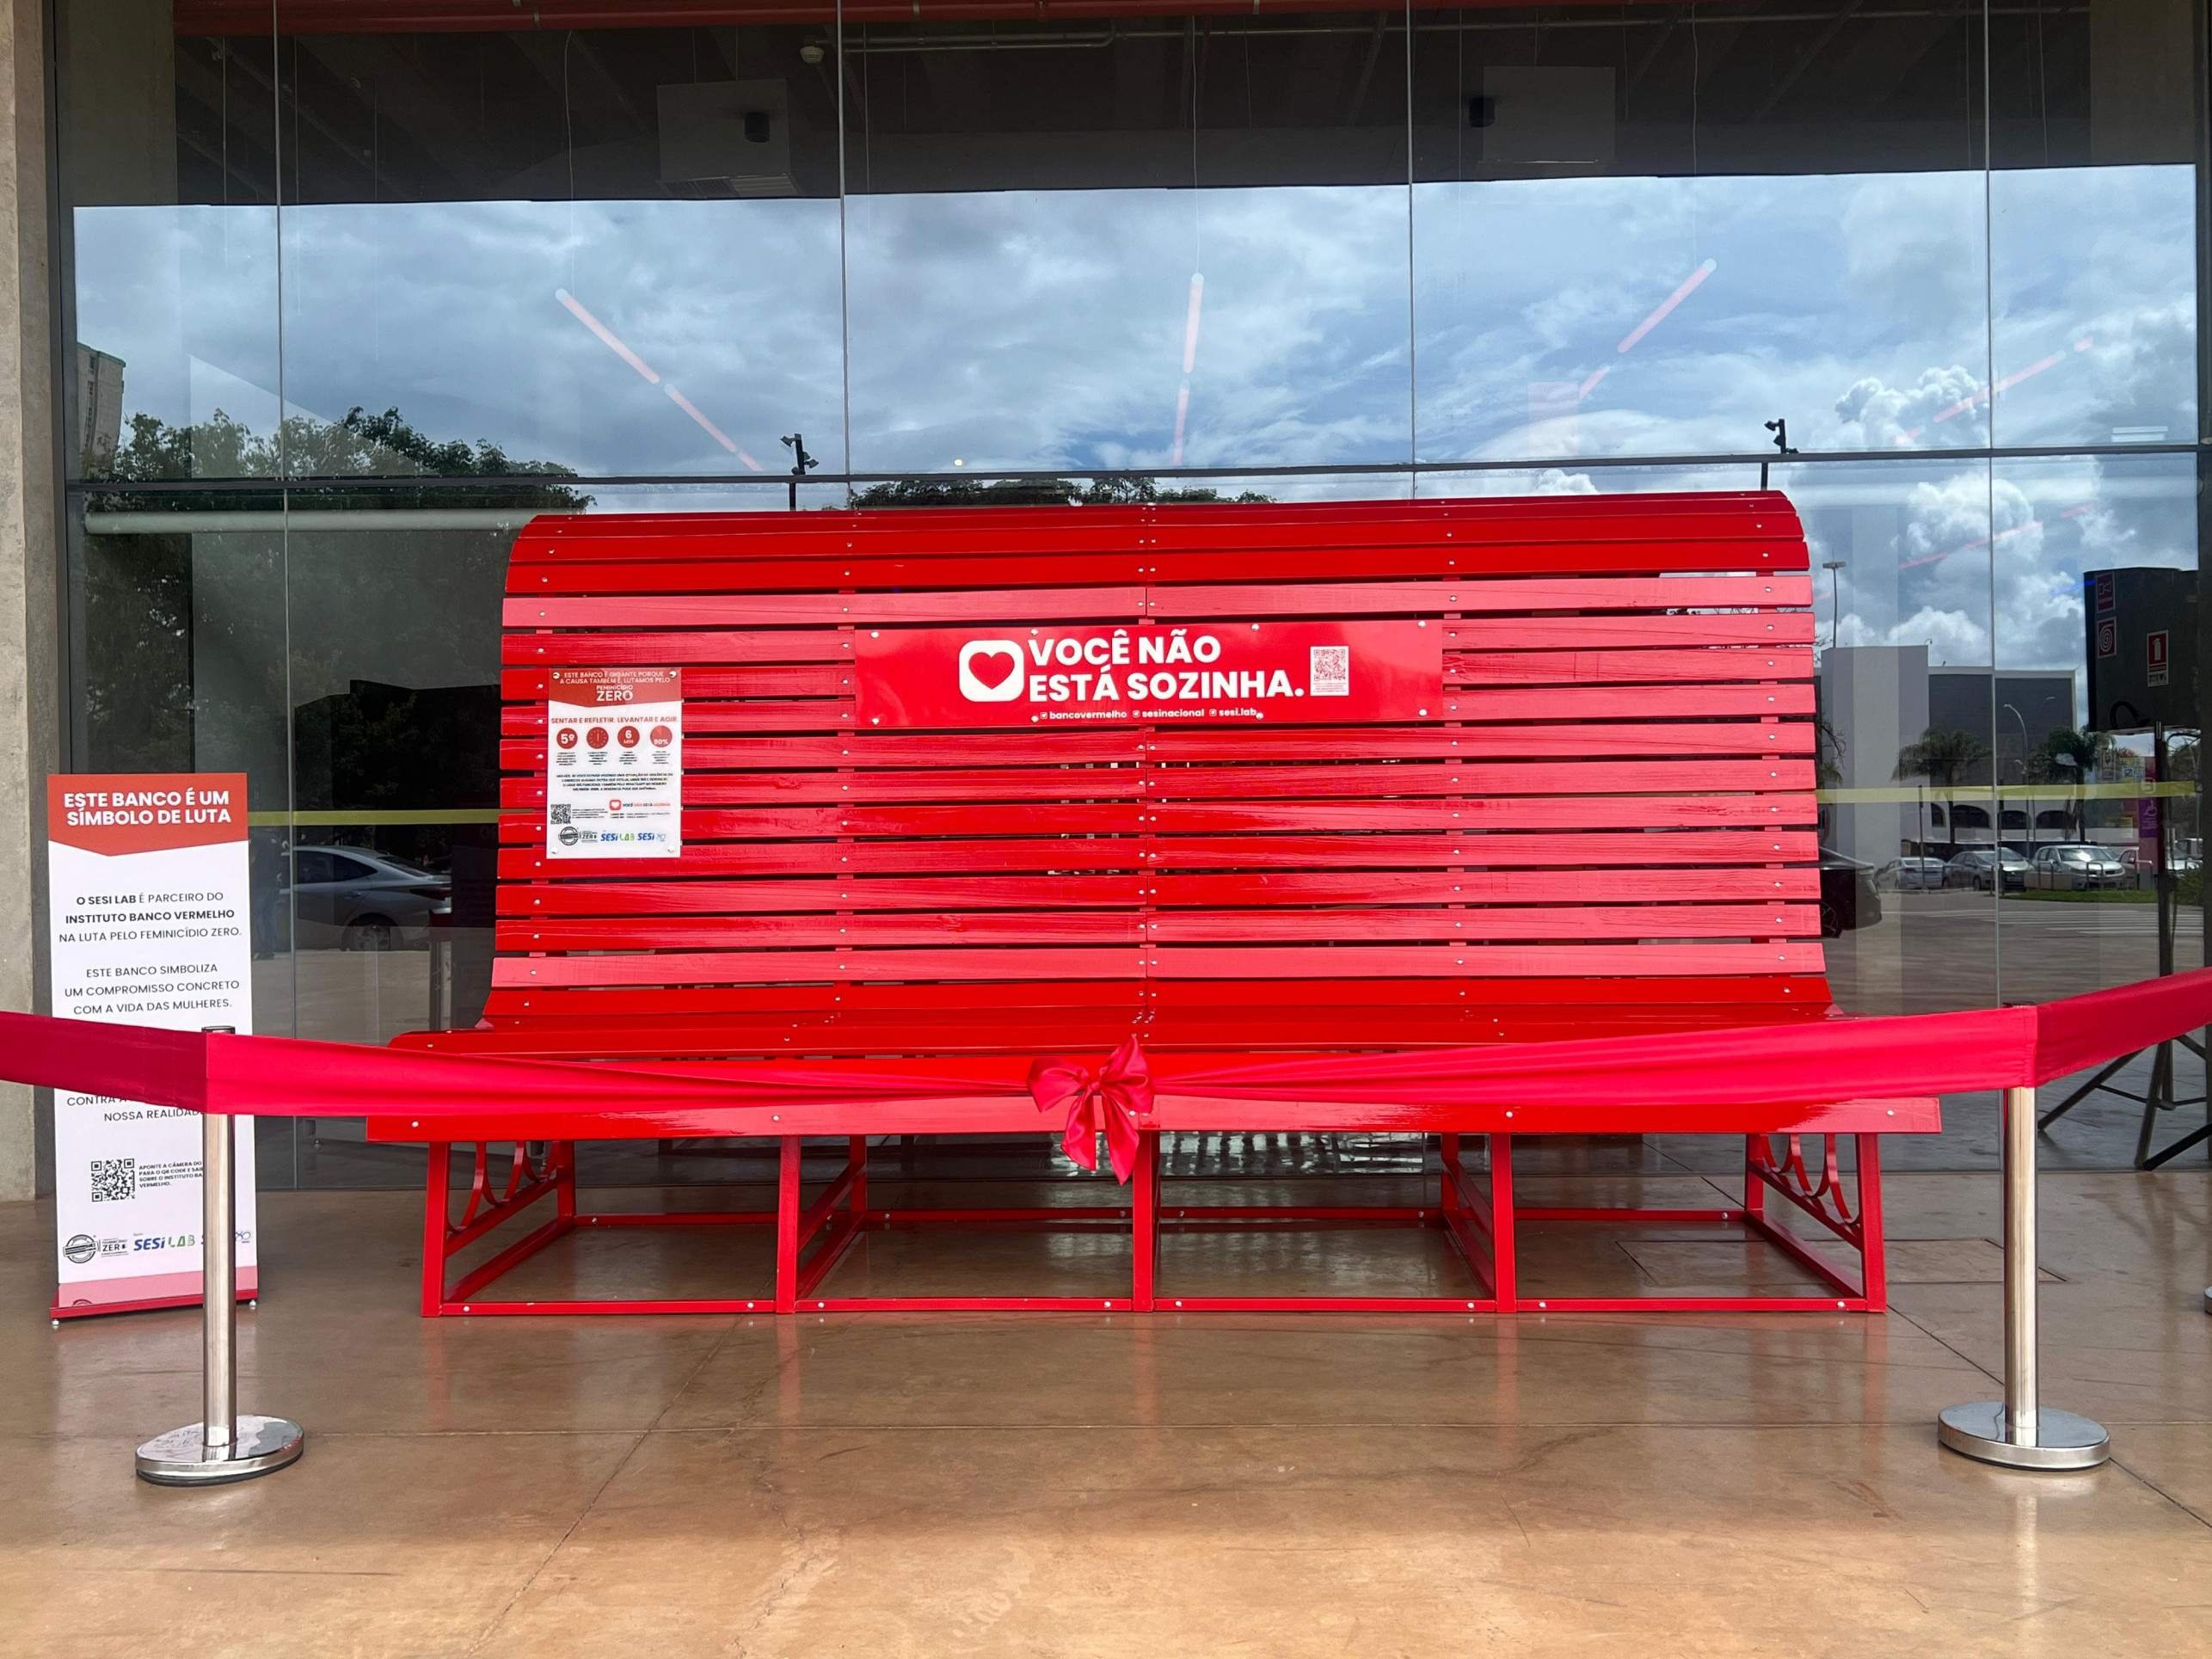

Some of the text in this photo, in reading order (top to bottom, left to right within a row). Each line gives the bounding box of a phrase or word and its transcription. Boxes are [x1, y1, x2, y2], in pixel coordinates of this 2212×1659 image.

[1029, 629, 1220, 666] VOCÊ NÃO
[1029, 667, 1305, 703] ESTÁ SOZINHA.
[596, 691, 633, 702] ZERO
[1049, 708, 1257, 720] bancovermelho sesinacional sesi.lab
[624, 729, 632, 739] 6
[64, 787, 230, 808] ESTE BANCO É UM
[67, 808, 232, 826] SÍMBOLO DE LUTA
[76, 892, 224, 905] O SESI LAB É PARCEIRO DO
[65, 909, 235, 924] INSTITUTO BANCO VERMELHO
[58, 926, 242, 943] NA LUTA PELO FEMINICÍDIO ZERO.
[86, 963, 218, 978] ESTE BANCO SIMBOLIZA
[65, 980, 240, 997] UM COMPROMISSO CONCRETO
[73, 998, 232, 1015] COM A VIDA DAS MULHERES.
[66, 1096, 115, 1107] CONTRA
[104, 1108, 201, 1121] NOSSA REALIDAD
[168, 1234, 195, 1247] LAB
